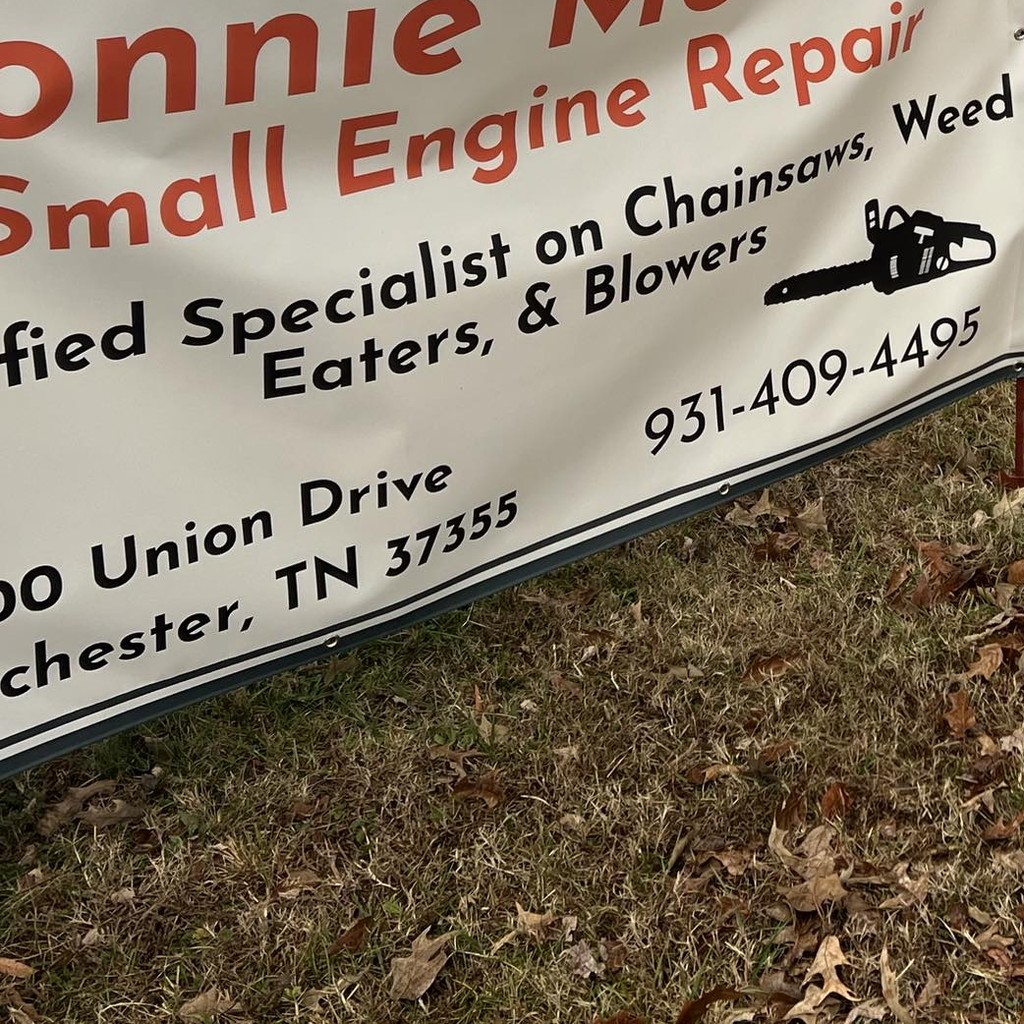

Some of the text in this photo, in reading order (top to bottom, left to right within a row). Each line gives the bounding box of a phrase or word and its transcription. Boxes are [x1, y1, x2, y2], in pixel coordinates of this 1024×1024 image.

[0, 1, 924, 256] Small Engine Repair
[0, 74, 1013, 387] fied Specialist on Chainsaws, Weed
[263, 225, 767, 399] Eaters, & Blowers
[645, 306, 981, 456] 931-409-4495
[0, 490, 518, 698] chester, TN 37355
[92, 511, 272, 588] Union
[301, 465, 452, 526] Drive
